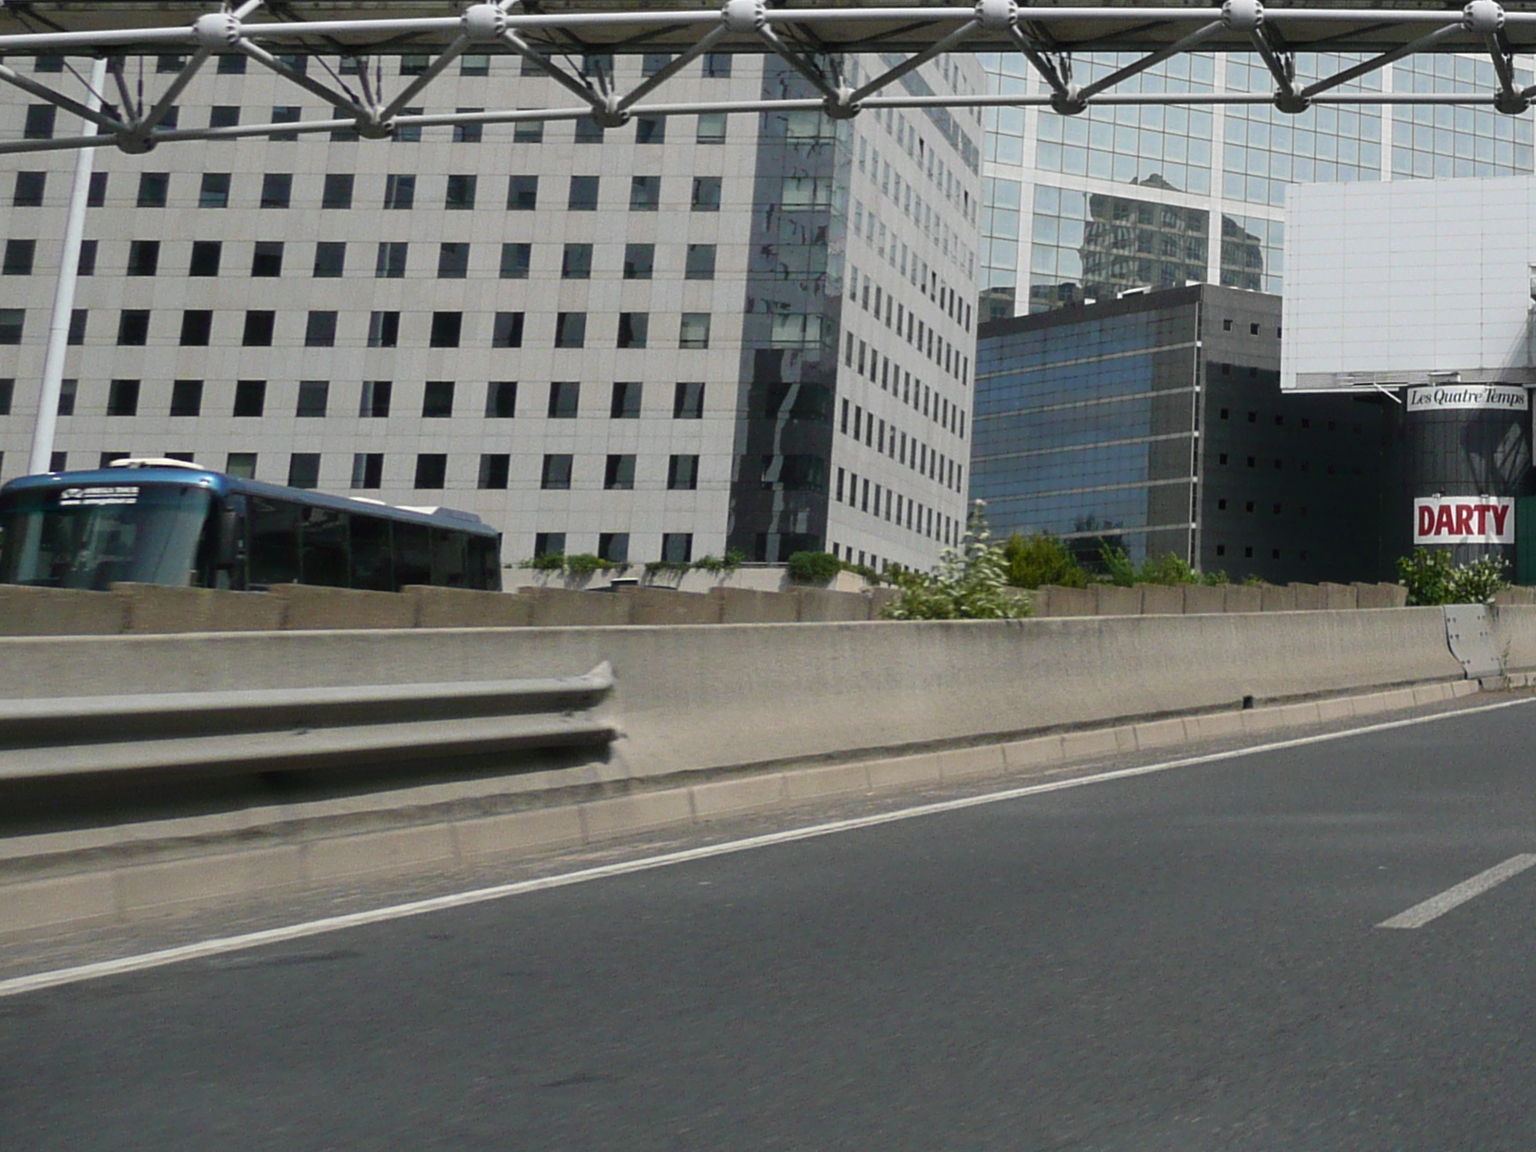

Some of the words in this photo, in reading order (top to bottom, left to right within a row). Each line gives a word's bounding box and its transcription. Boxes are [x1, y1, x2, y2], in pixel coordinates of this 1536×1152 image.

[1411, 390, 1432, 405] Les
[1434, 389, 1482, 405] Quatre
[1484, 388, 1525, 406] Temps
[1418, 504, 1510, 536] DARTY
